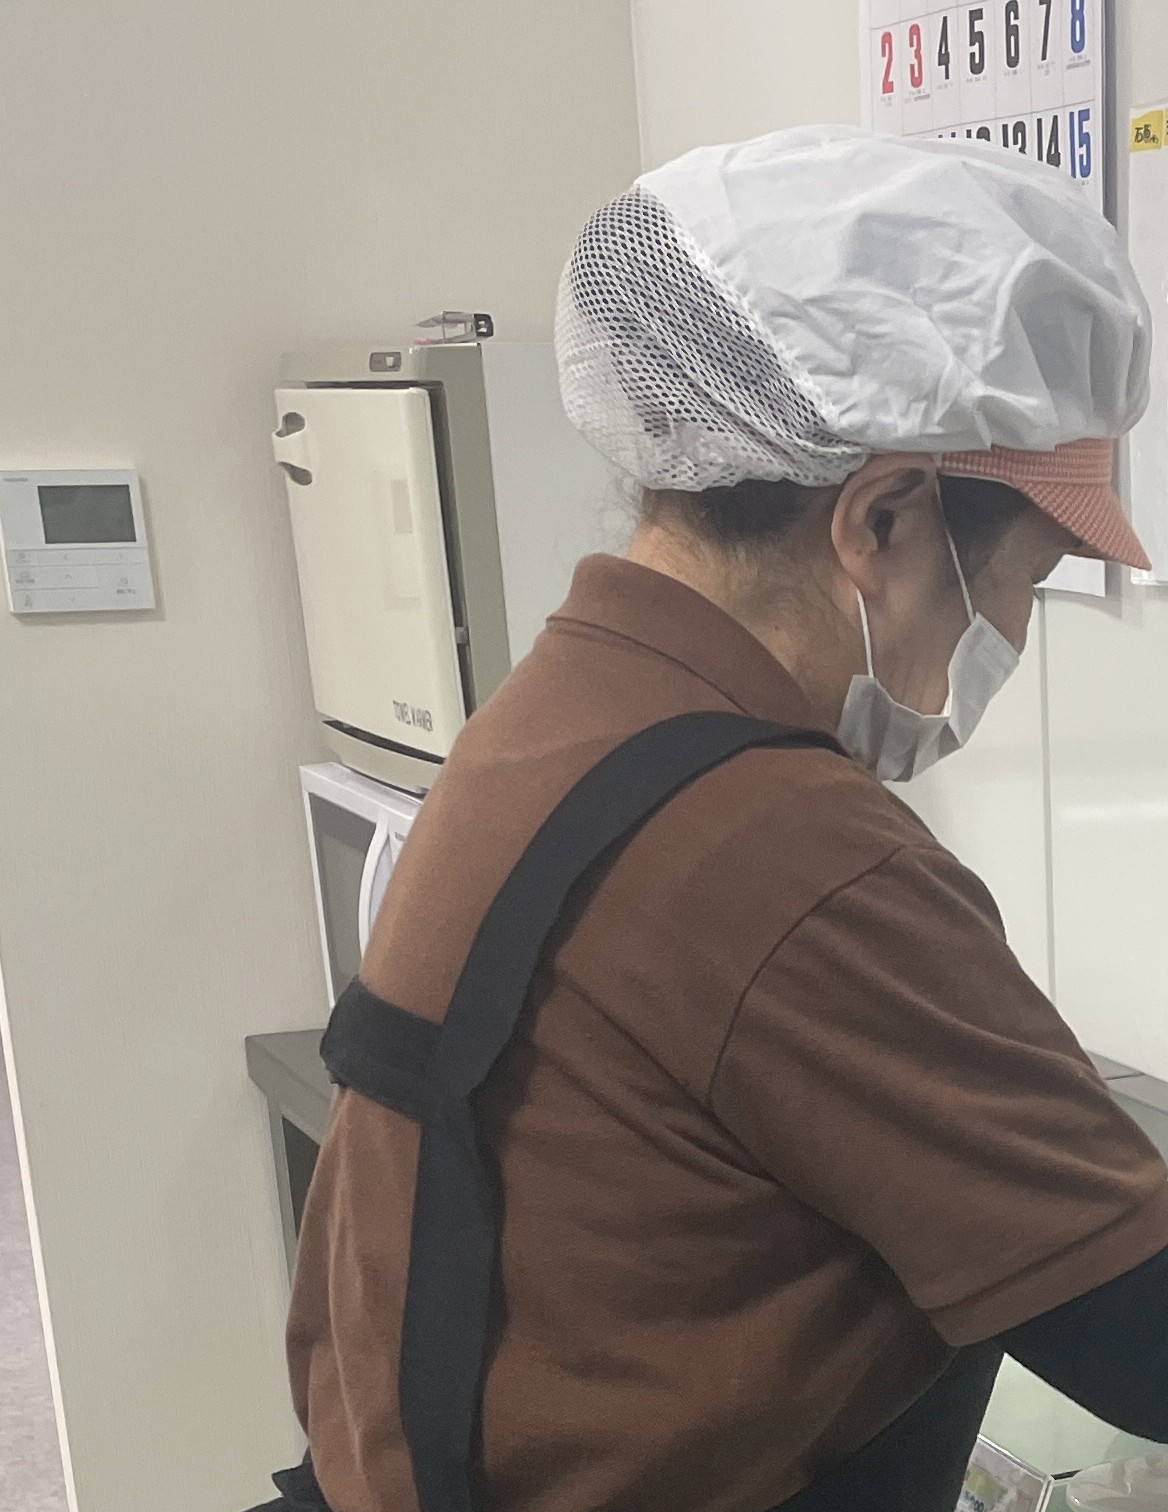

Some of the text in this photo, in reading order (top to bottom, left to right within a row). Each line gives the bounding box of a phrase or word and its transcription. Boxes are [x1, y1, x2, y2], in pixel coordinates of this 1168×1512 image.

[881, 0, 1087, 95] 2 3 4 5 6 7 8
[1037, 115, 1061, 168] 14
[1069, 108, 1092, 179] 15
